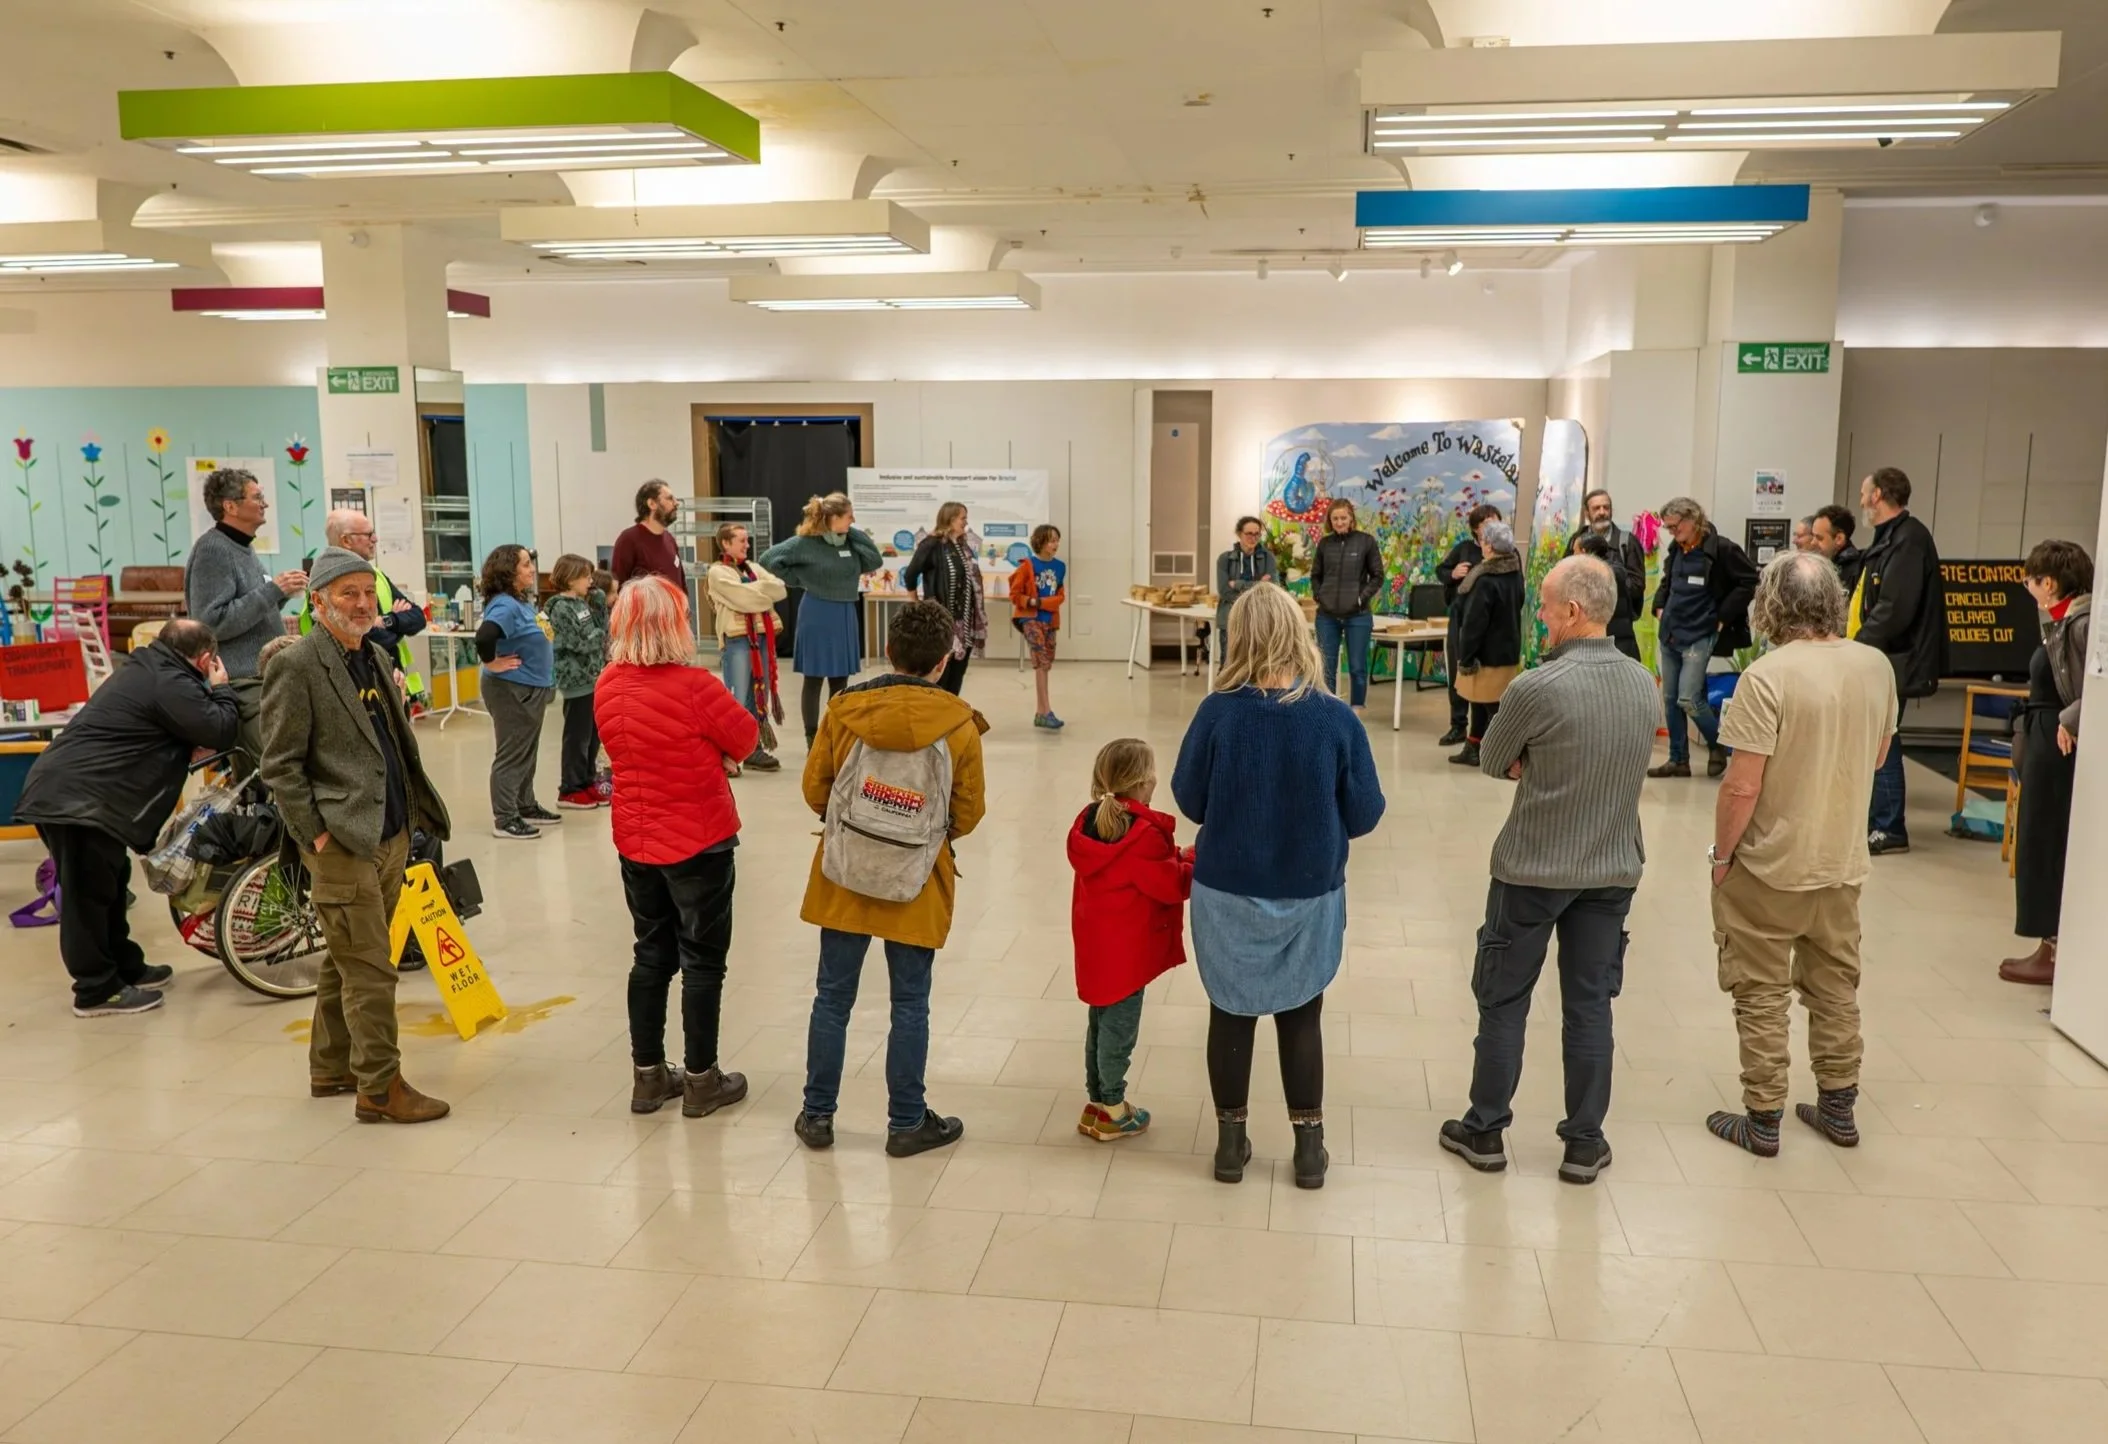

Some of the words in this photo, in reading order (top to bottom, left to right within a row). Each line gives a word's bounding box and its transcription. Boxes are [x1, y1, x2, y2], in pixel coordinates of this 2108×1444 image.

[1783, 354, 1825, 370] EXIT
[362, 376, 396, 391] EXIT
[1365, 440, 1429, 492] Welcome
[1432, 430, 1451, 455] To
[1945, 591, 2007, 607] CANCELLED
[1947, 609, 1996, 624] DELAYED
[1993, 628, 2014, 642] CUT
[420, 907, 447, 925] CAUTION
[450, 964, 473, 982] WET
[450, 973, 480, 994] FLOOR
